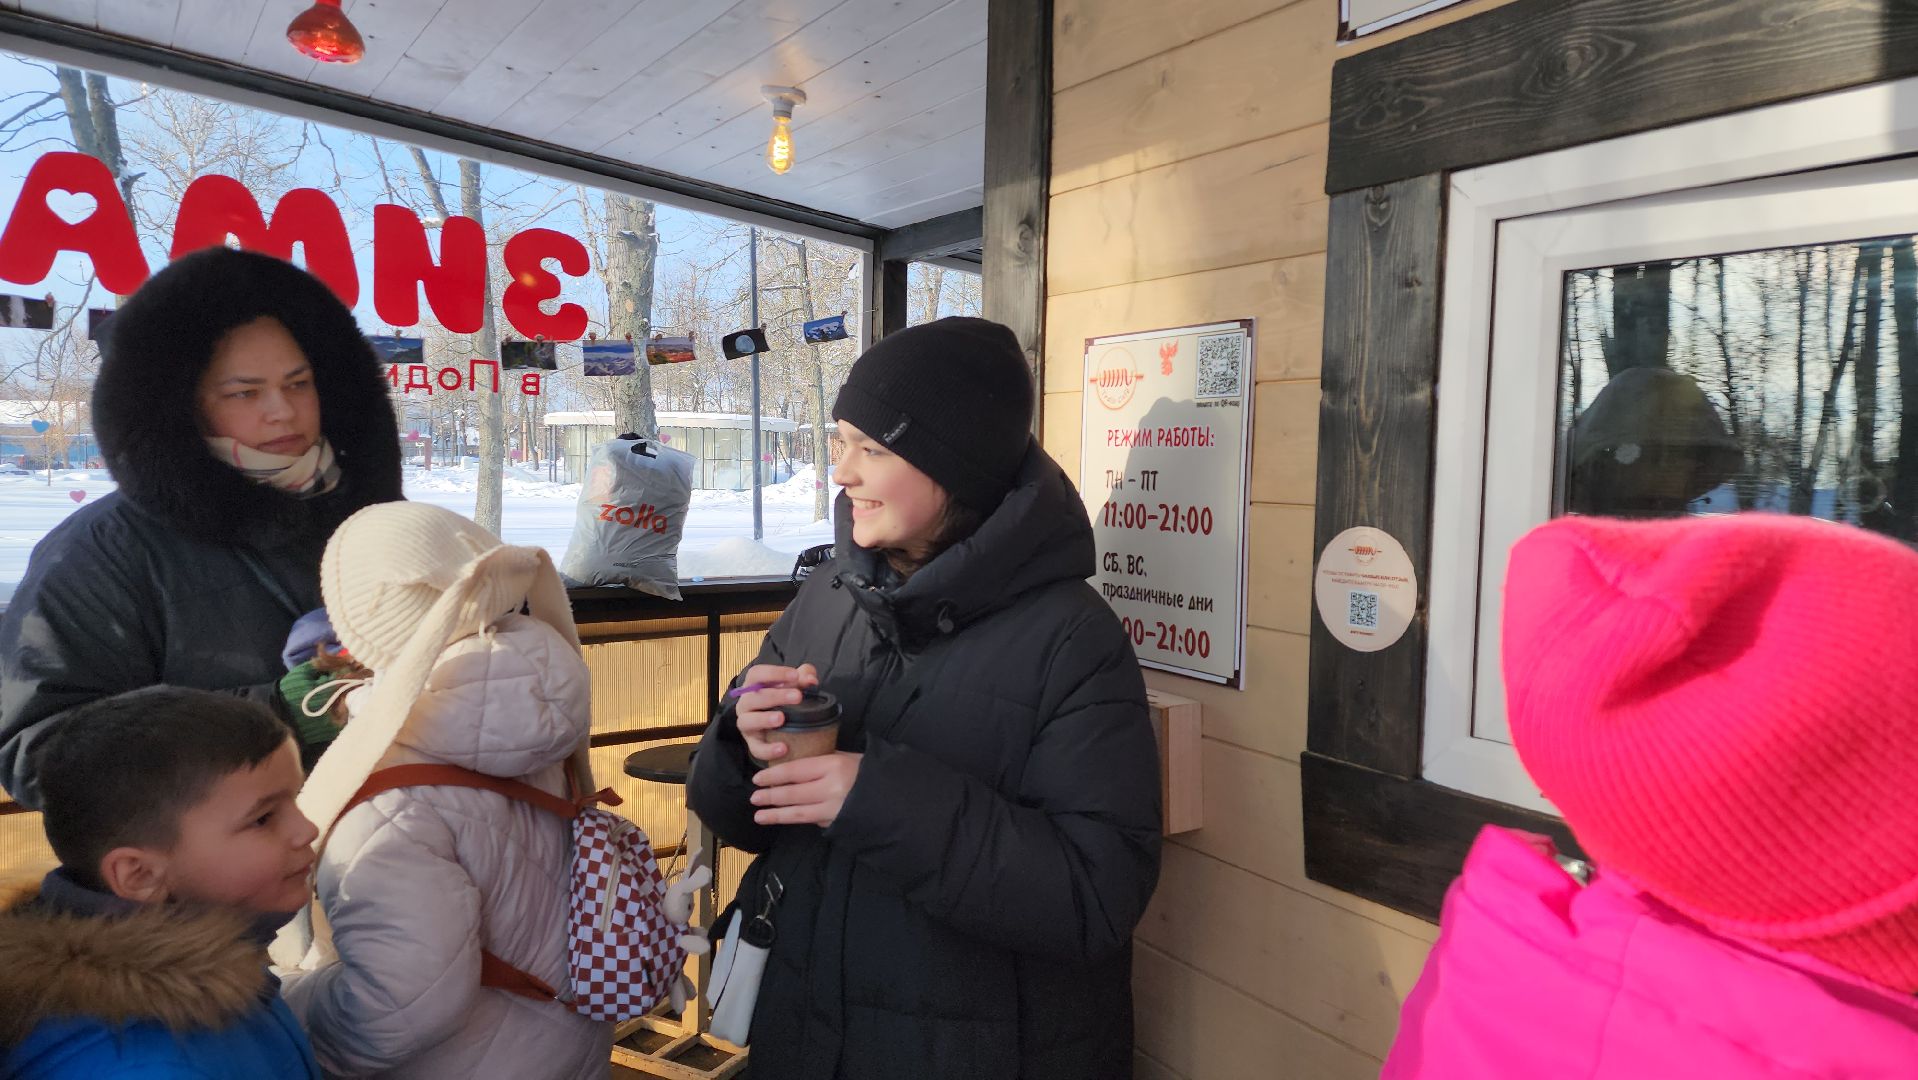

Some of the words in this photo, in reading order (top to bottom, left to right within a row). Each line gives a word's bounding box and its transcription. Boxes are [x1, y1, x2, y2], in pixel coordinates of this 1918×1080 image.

[1107, 428, 1153, 448] РЕЖИМ
[1157, 426, 1216, 447] РАБОТЫ:
[1105, 469, 1123, 490] ПН
[1140, 470, 1159, 491] ПТ
[598, 503, 668, 535] zolla
[1103, 501, 1213, 536] 11:00-21:00
[1102, 582, 1184, 608] праздничные
[1188, 595, 1213, 613] дни
